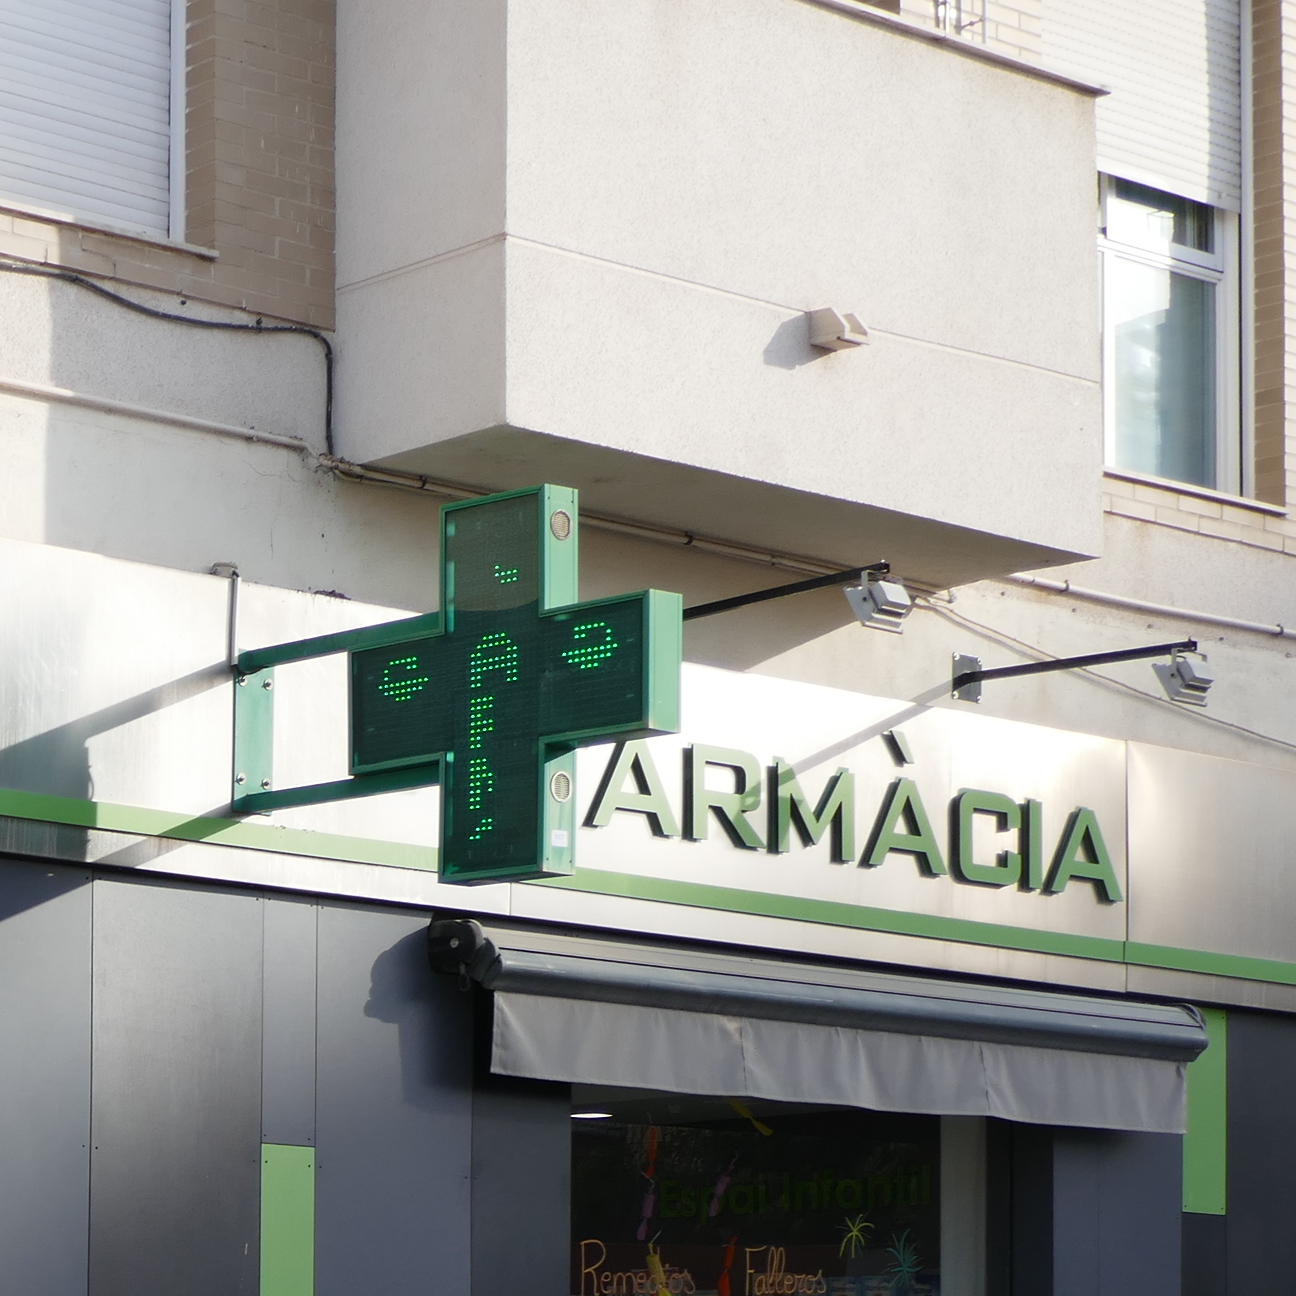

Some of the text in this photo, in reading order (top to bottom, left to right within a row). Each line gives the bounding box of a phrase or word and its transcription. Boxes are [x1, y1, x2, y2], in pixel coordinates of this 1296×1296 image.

[584, 731, 1122, 903] ARMÀCIA
[659, 1163, 933, 1226] Espai Infantil
[580, 1239, 827, 1296] Remedos Falleros
